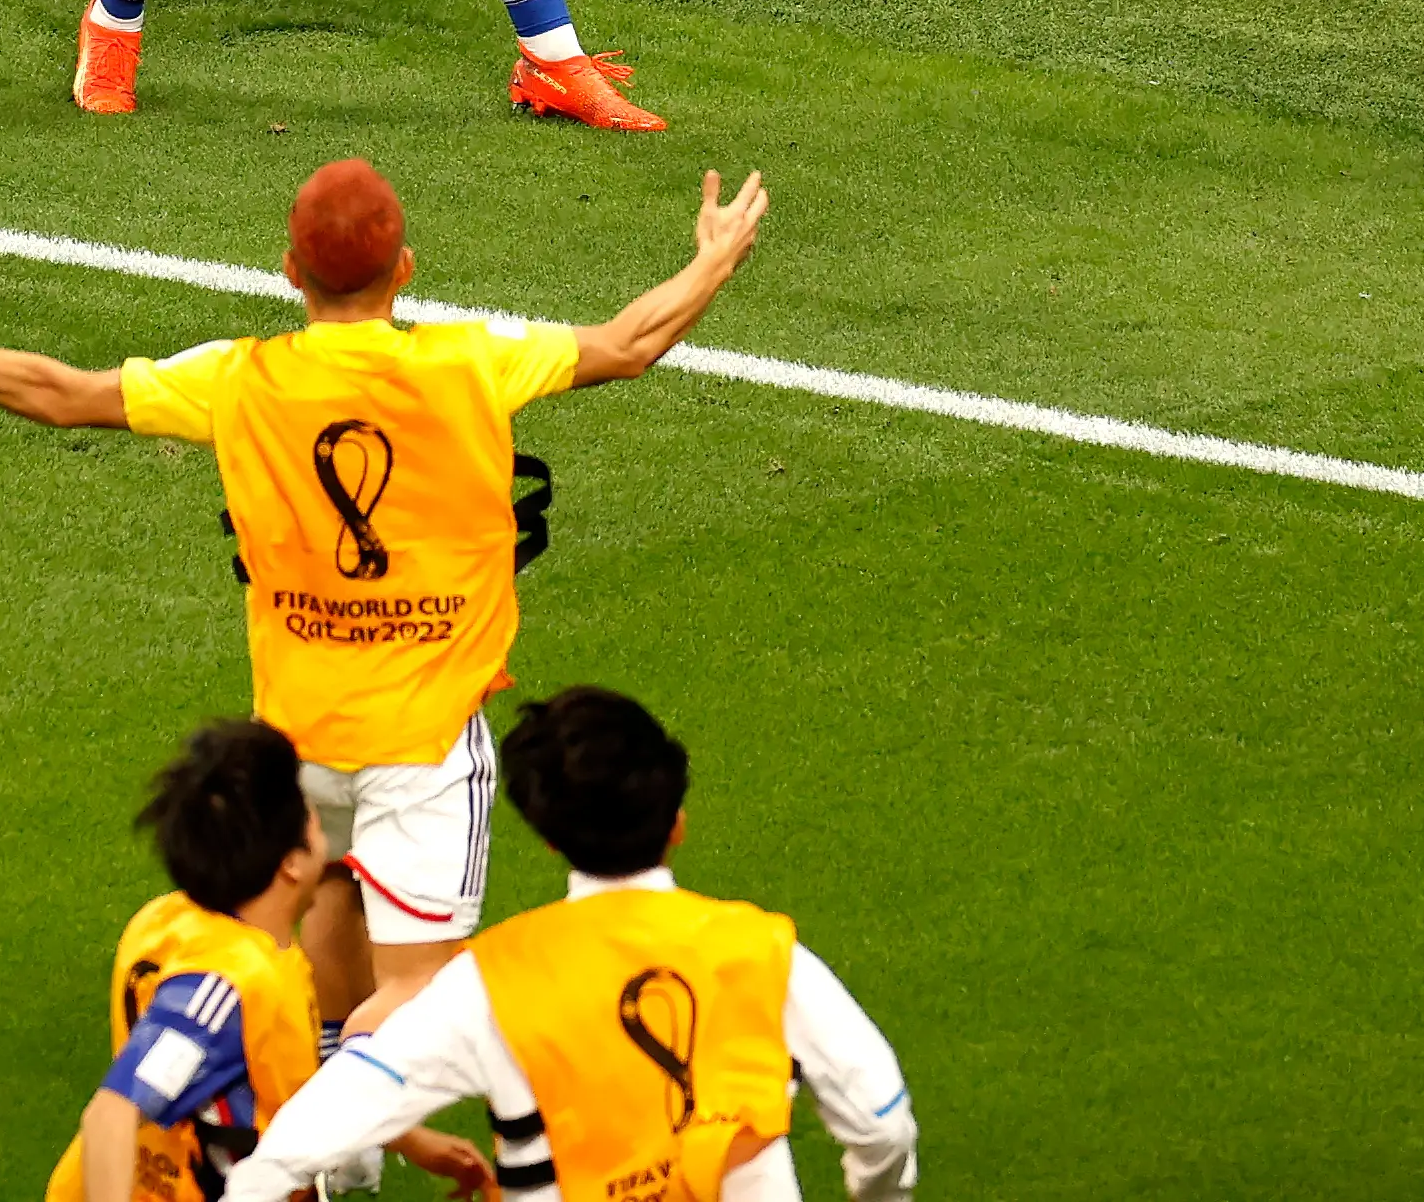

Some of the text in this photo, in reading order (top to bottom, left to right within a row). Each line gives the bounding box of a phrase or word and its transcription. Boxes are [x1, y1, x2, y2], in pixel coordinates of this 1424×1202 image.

[273, 590, 466, 618] FIFA WORLD CUP
